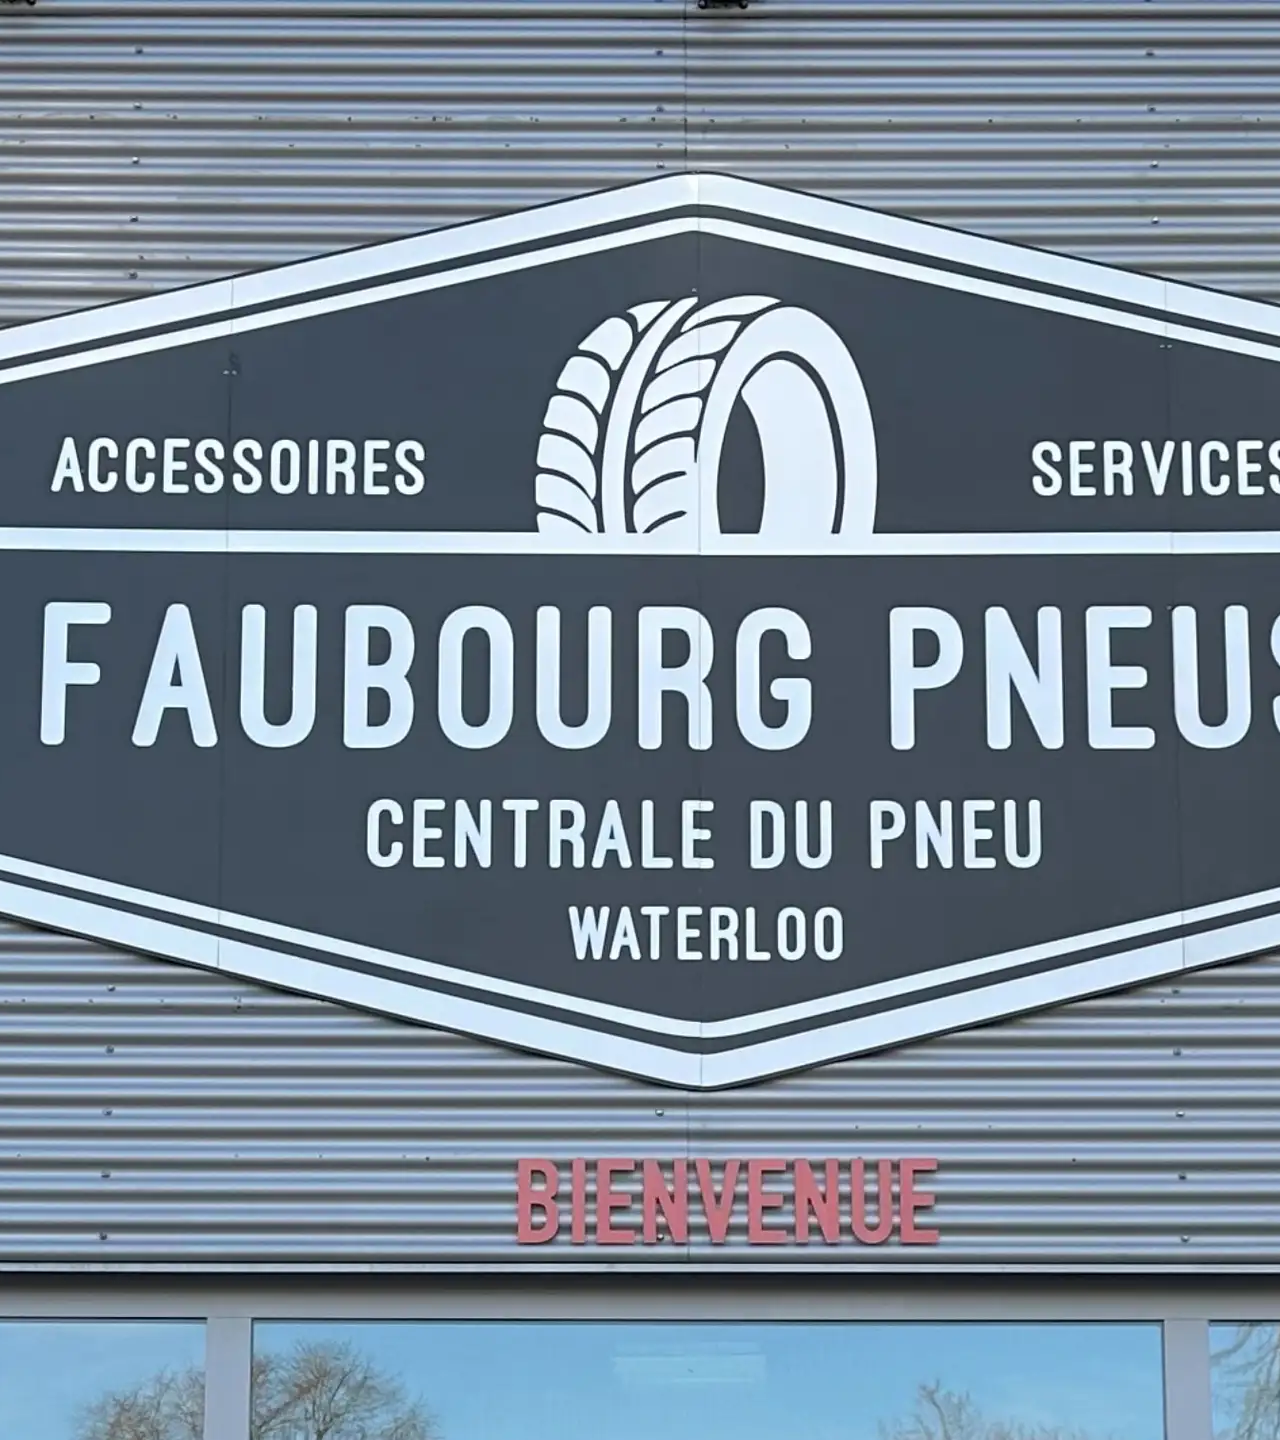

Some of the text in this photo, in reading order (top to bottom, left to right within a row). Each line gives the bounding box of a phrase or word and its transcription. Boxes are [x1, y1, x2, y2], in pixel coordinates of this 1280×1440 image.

[50, 436, 427, 497] ACCESSOIRES
[39, 601, 814, 751] FAUBOURG
[365, 798, 1043, 870] CENTRALE DU PNEU
[568, 905, 845, 962] WATERLOO
[516, 1158, 940, 1245] BIENVENUE
